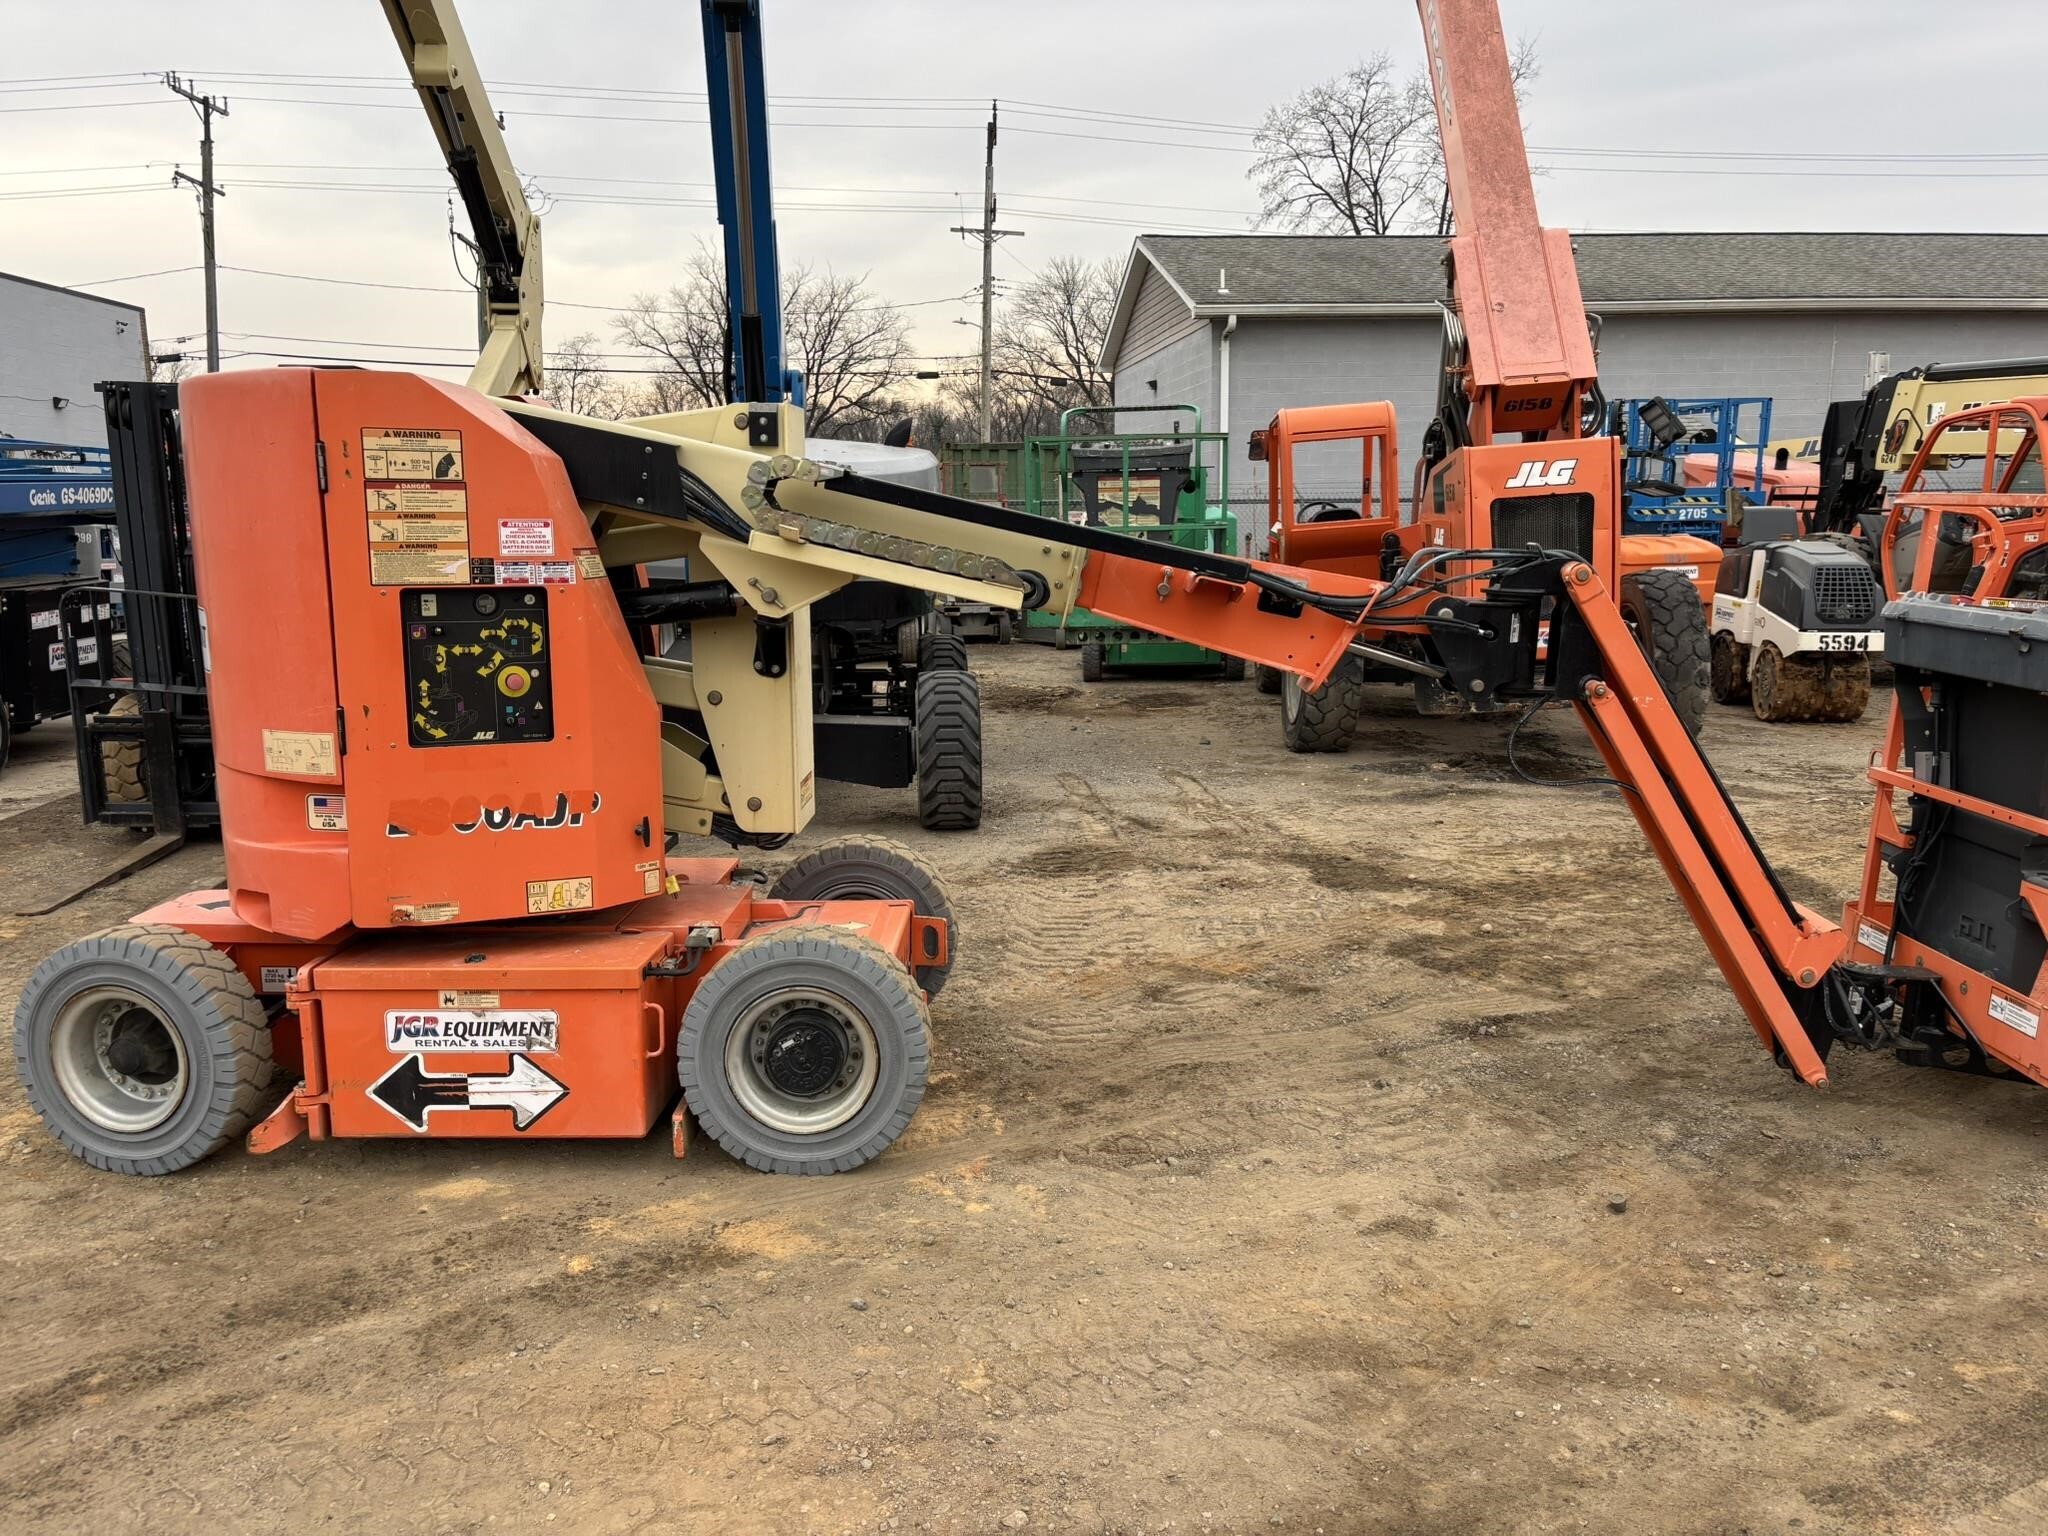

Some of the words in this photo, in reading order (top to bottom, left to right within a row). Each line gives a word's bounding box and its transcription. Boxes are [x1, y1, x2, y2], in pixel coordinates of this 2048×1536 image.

[1504, 398, 1552, 412] 6158
[392, 430, 441, 439] WARNING
[1796, 440, 1820, 458] JL
[1880, 454, 1897, 464] 6247
[1504, 458, 1578, 489] JLG
[29, 489, 57, 506] Genie
[61, 487, 114, 504] GS-4069DC
[1679, 508, 1708, 520] 2705
[1434, 528, 1445, 546] JLG
[1818, 634, 1869, 651] 5594
[78, 643, 97, 657] PMENT
[473, 731, 495, 740] JLG
[391, 1015, 440, 1043] JGR
[443, 1021, 555, 1042] EQUIPMENT
[415, 1039, 466, 1047] RENTAL
[470, 1039, 479, 1047] &
[483, 1039, 526, 1047] SALES
